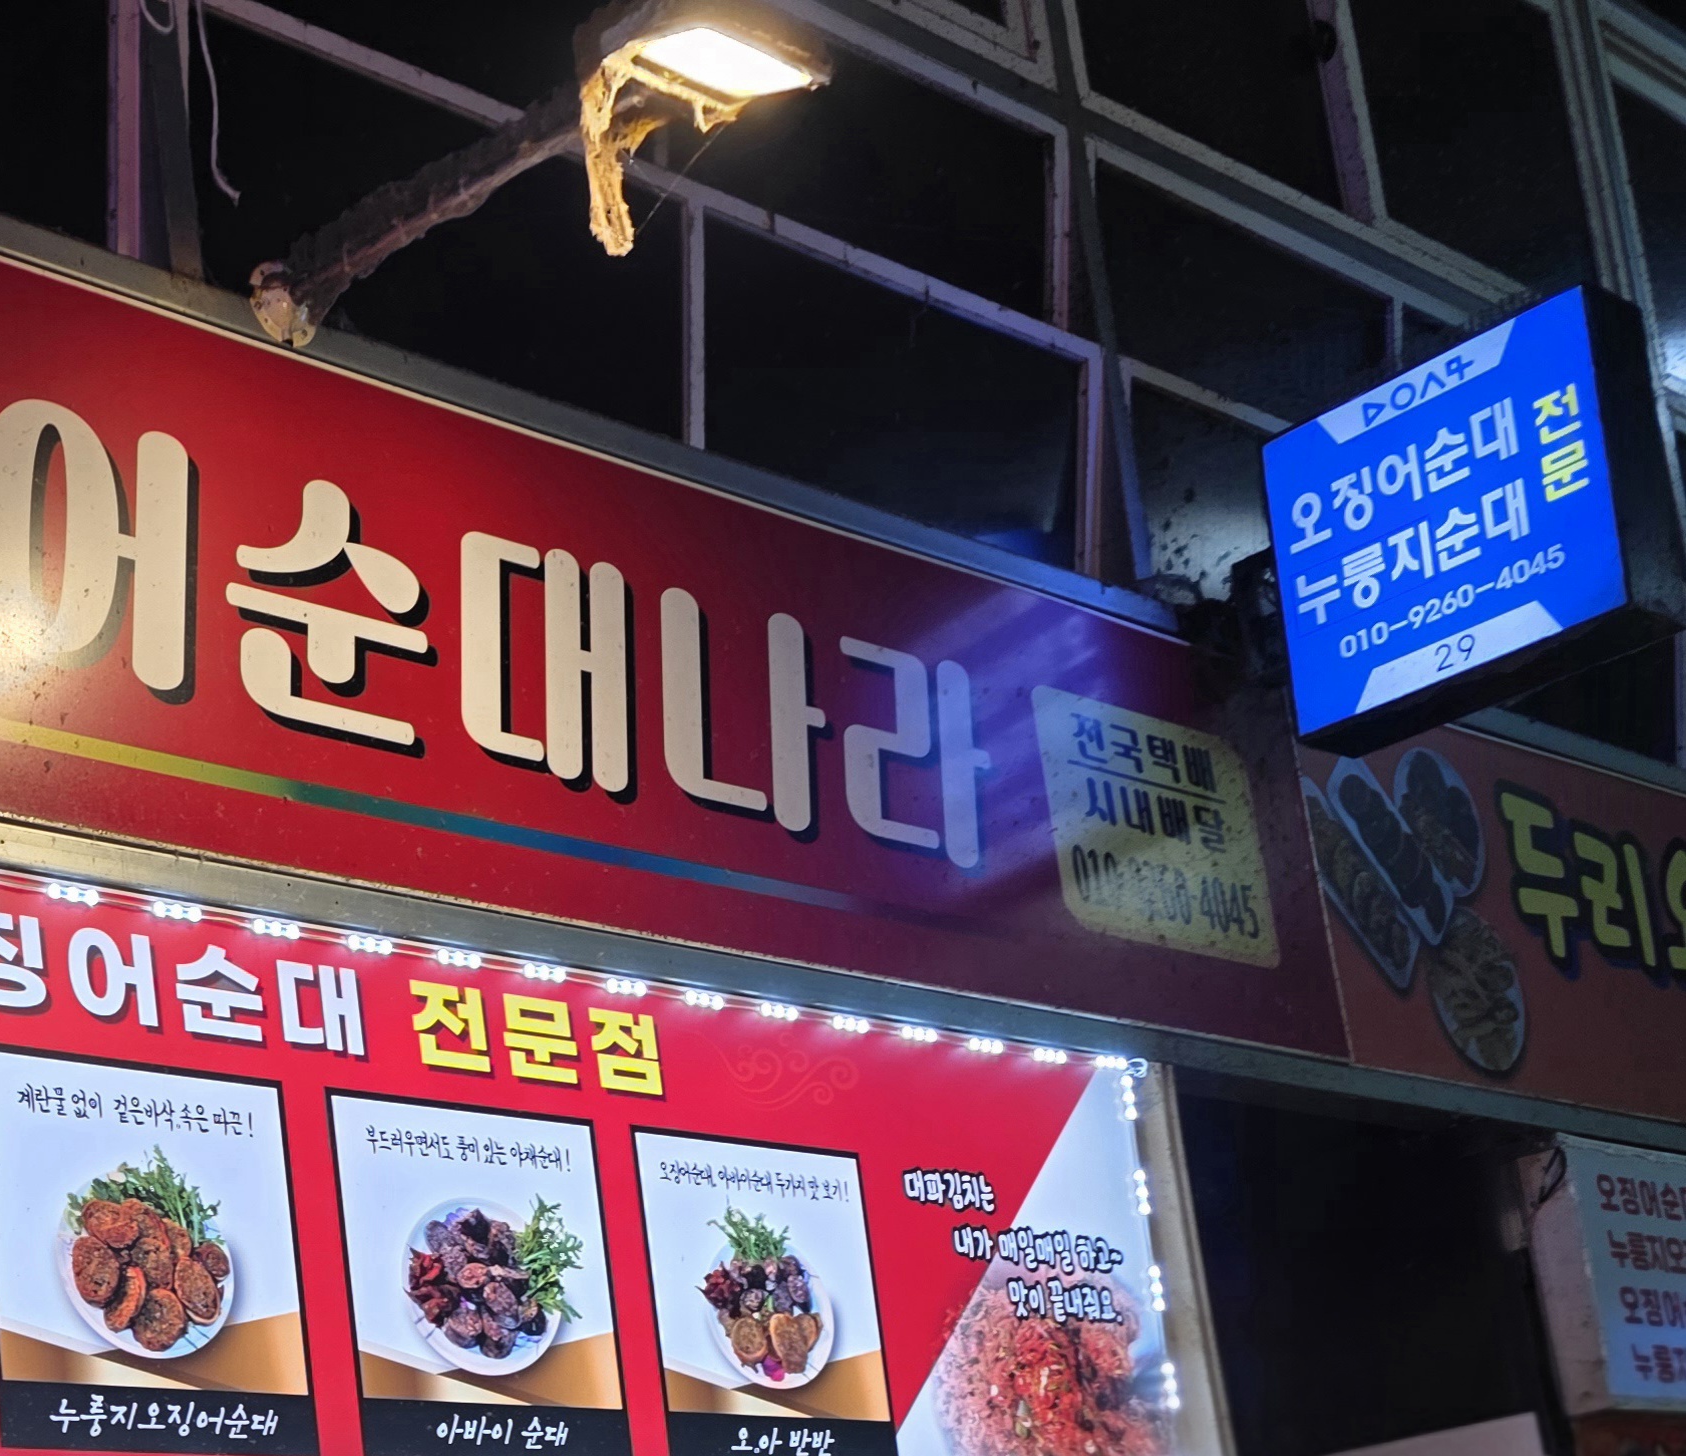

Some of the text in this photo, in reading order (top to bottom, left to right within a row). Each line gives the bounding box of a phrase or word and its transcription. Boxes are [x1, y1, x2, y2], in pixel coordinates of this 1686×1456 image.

[1532, 382, 1590, 503] 전문
[1289, 396, 1519, 555] 오징어순대
[1295, 478, 1531, 626] 누룽지순대
[1338, 543, 1567, 659] 010-9260-4045
[1434, 632, 1476, 672] 29
[1070, 712, 1218, 794] 전국택배
[1084, 776, 1227, 853] 시내배달
[408, 976, 666, 1097] 전문점
[16, 1083, 67, 1117] 계란물
[70, 1089, 104, 1119] 없이
[365, 1125, 455, 1161] 부드러우면서도
[456, 1136, 480, 1162] 풍미
[483, 1137, 509, 1166] 있는
[902, 1167, 996, 1215] 대파김치는
[1596, 1173, 1686, 1221] 오징어순
[953, 1226, 994, 1261] 내가
[997, 1227, 1074, 1275] 매일매일
[1007, 1278, 1047, 1320] 맛이
[49, 1394, 280, 1439] 누룽지오징어순대
[436, 1413, 570, 1452] 아바이 순대
